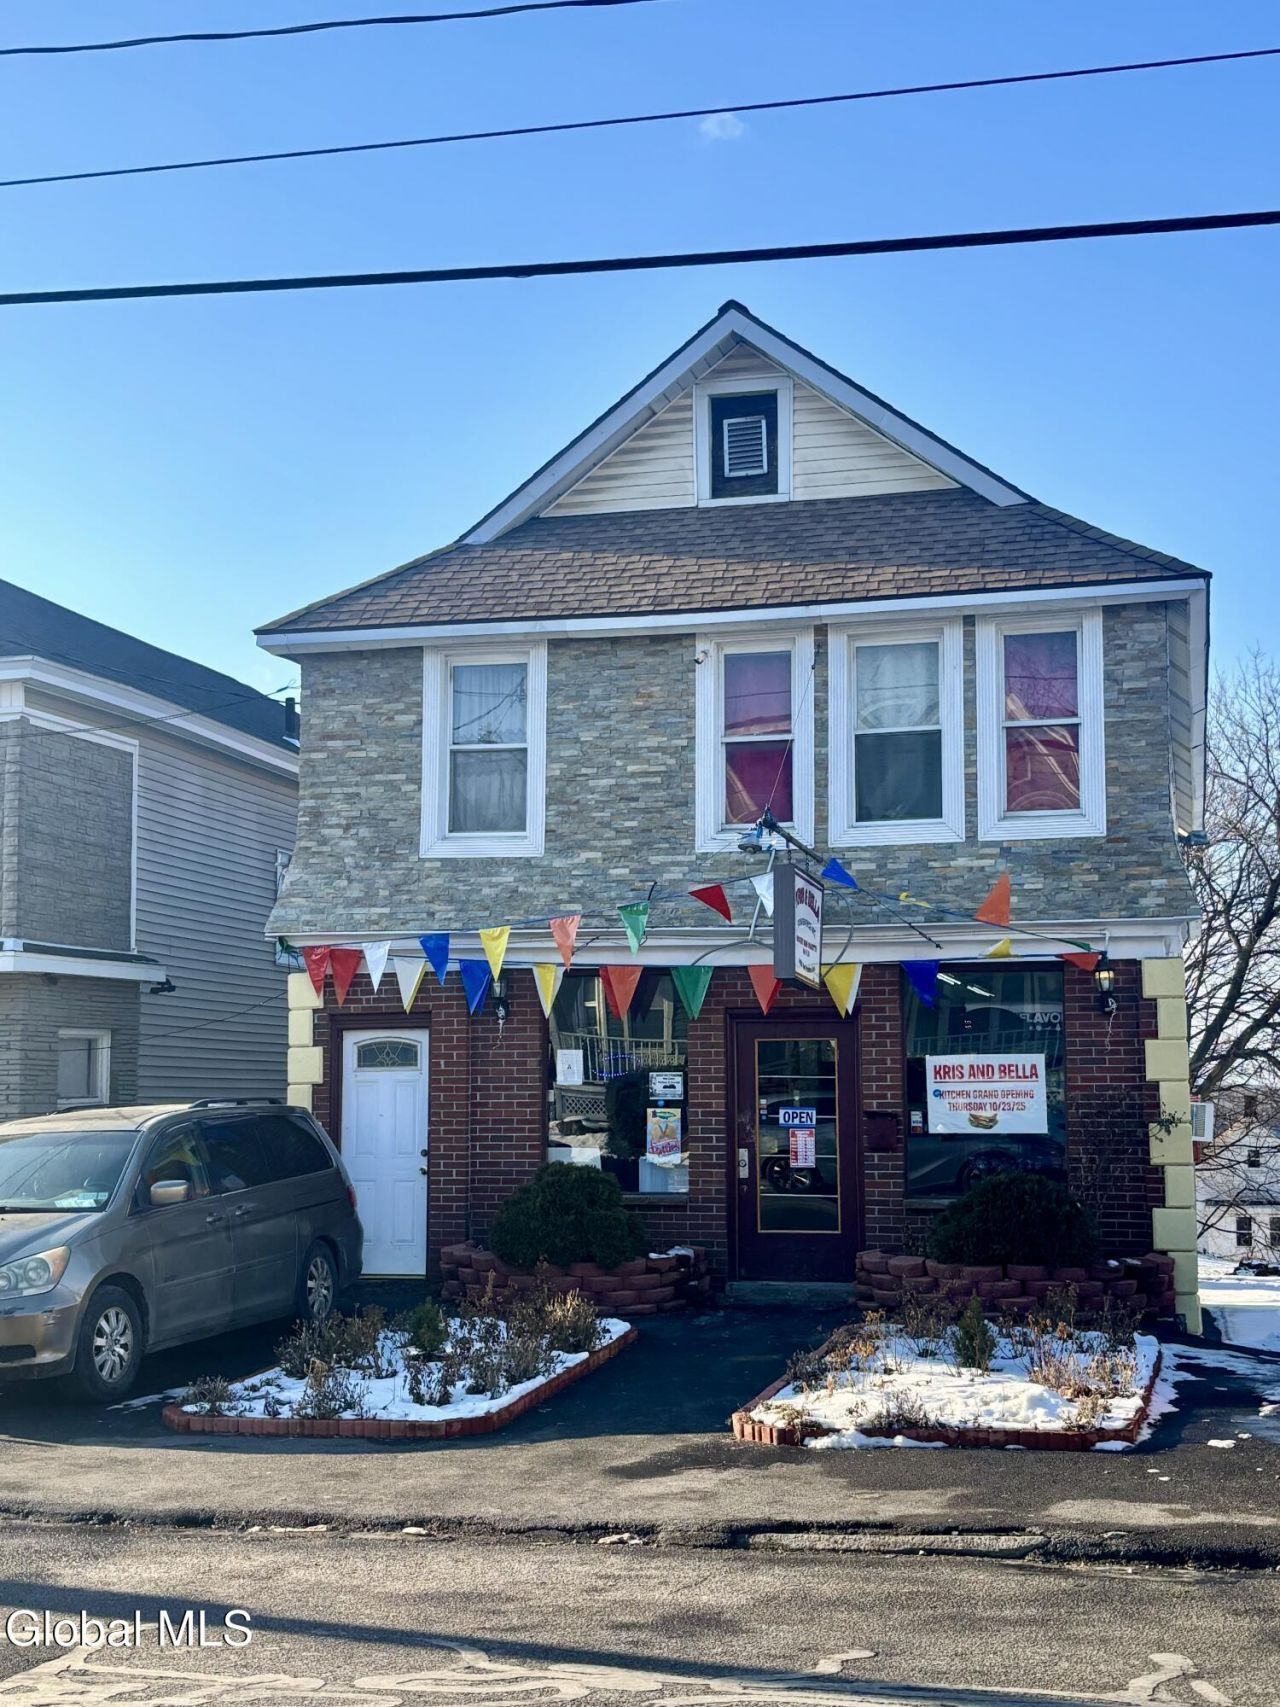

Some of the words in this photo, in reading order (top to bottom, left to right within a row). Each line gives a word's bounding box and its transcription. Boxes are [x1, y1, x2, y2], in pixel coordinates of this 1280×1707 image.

[933, 1064, 965, 1080] KRIS
[968, 1063, 995, 1080] AND
[998, 1063, 1039, 1079] BELLA
[939, 1089, 971, 1100] KITCHEN
[973, 1089, 999, 1099] GRAND
[1000, 1089, 1035, 1099] OPENING
[947, 1101, 987, 1112] THURSDAY
[989, 1101, 1026, 1112] 10/23/25
[783, 1110, 814, 1124] OPEN
